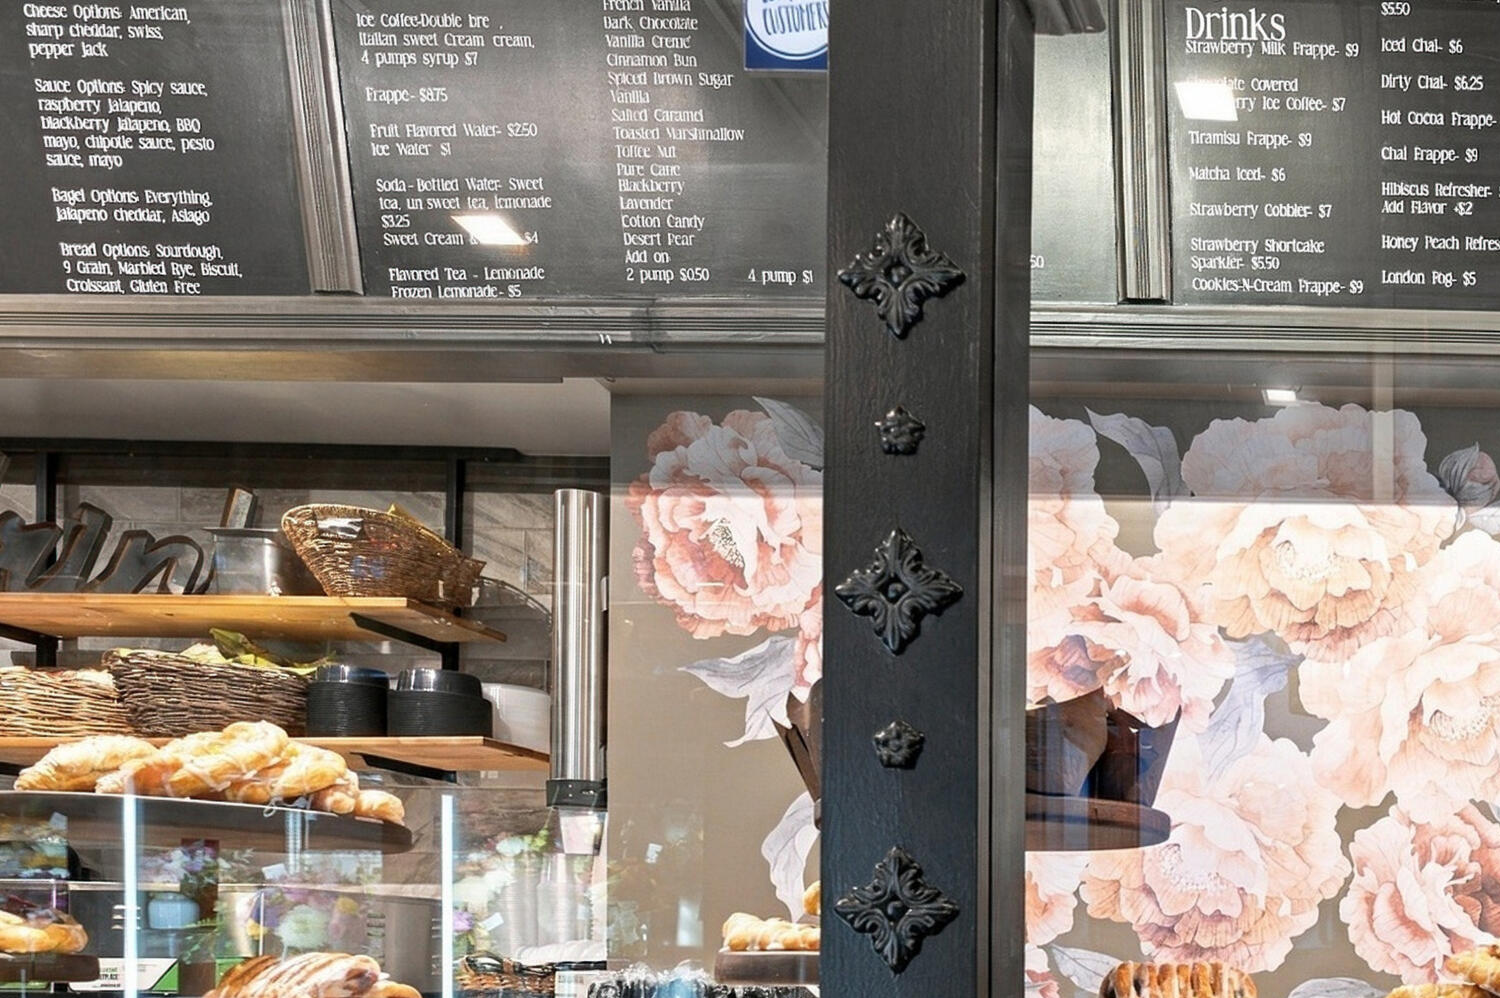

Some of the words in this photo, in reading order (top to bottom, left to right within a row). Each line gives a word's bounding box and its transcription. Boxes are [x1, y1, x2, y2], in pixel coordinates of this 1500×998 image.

[24, 4, 67, 18] Cheese
[130, 6, 190, 24] American,
[356, 13, 374, 27] Ice
[26, 22, 63, 39] sharp
[69, 24, 122, 39] cheddar,
[604, 16, 633, 29] Dark
[640, 17, 698, 30] Chocolate
[1186, 7, 1285, 41] Drinks
[359, 32, 397, 45] Italian
[404, 33, 438, 46] sweet
[444, 33, 484, 46] Cream
[493, 36, 534, 48] cream,
[1382, 38, 1405, 52] Iced
[1449, 39, 1463, 53] $6
[29, 43, 74, 59] pepper
[82, 42, 108, 57] jack
[1186, 40, 1253, 58] Strawberry
[1262, 41, 1286, 55] Milk
[1346, 43, 1358, 57] $9
[376, 53, 416, 67] pumps
[423, 53, 458, 68] syrup
[465, 52, 477, 65] $7
[607, 54, 667, 66] Cinnamon
[674, 54, 697, 67] Bun
[35, 79, 71, 92] Sauce
[132, 80, 163, 97] Spicy
[170, 83, 207, 96] sauce,
[699, 73, 733, 89] Sugar
[1251, 78, 1298, 91] Covered
[1382, 74, 1411, 91] Dirty
[1455, 76, 1483, 90] $6.25
[38, 97, 100, 114] raspberry
[1263, 96, 1280, 110] Ice
[1332, 98, 1345, 111] $7
[654, 109, 703, 122] Caramel
[1382, 110, 1401, 124] Hot
[1408, 111, 1444, 125] Cocoa
[40, 116, 109, 133] blackberry
[176, 118, 200, 133] BBQ
[370, 124, 399, 138] Fruit
[406, 124, 457, 137] Flavored
[613, 127, 659, 139] Toasted
[667, 128, 744, 141] Marshmallow
[1188, 131, 1240, 144] Tiramisu
[1299, 133, 1311, 147] $9
[43, 136, 79, 150] mayo,
[85, 135, 133, 152] chipotle
[139, 138, 175, 151] sauce,
[181, 137, 214, 153] pesto
[371, 143, 390, 156] Ice
[396, 143, 431, 155] Water
[1381, 146, 1407, 160] Chai
[1465, 148, 1477, 162] $9
[1189, 166, 1230, 180] Matcha
[1271, 168, 1285, 182] $6
[619, 179, 684, 195] Blackberry
[1382, 182, 1429, 196] Hibiscus
[51, 187, 85, 206] Bagel
[620, 196, 673, 210] Lavender
[1190, 203, 1258, 219] Strawberry
[1319, 204, 1332, 218] $7
[1382, 201, 1403, 213] Add
[1411, 201, 1447, 214] Flavor
[114, 208, 165, 223] cheddar,
[172, 209, 209, 225] Asiago
[621, 215, 660, 227] Cotton
[667, 214, 704, 231] Candy
[384, 233, 419, 245] Sweet
[425, 232, 463, 245] Cream
[624, 233, 661, 245] Desert
[668, 233, 695, 245] Pear
[1191, 238, 1258, 254] Strawberry
[1265, 239, 1324, 253] Shortcake
[1382, 235, 1418, 252] Honey
[1425, 236, 1459, 249] Peach
[59, 242, 96, 256] Bread
[156, 244, 223, 261] Sourdough,
[63, 260, 71, 273] 9
[77, 261, 113, 275] Grain,
[118, 261, 166, 275] Marbled
[171, 262, 195, 279] Rye,
[201, 263, 242, 277] Biscuit,
[389, 268, 439, 281] Flavored
[444, 268, 466, 280] Tea
[484, 266, 544, 280] Lemonade
[640, 270, 674, 283] pump
[67, 279, 124, 293] Croissant,
[130, 280, 167, 292] Gluten
[174, 281, 200, 293] Free
[762, 271, 796, 285] pump
[1382, 270, 1425, 284] London
[1463, 271, 1476, 286] $5
[1350, 280, 1363, 293] $9
